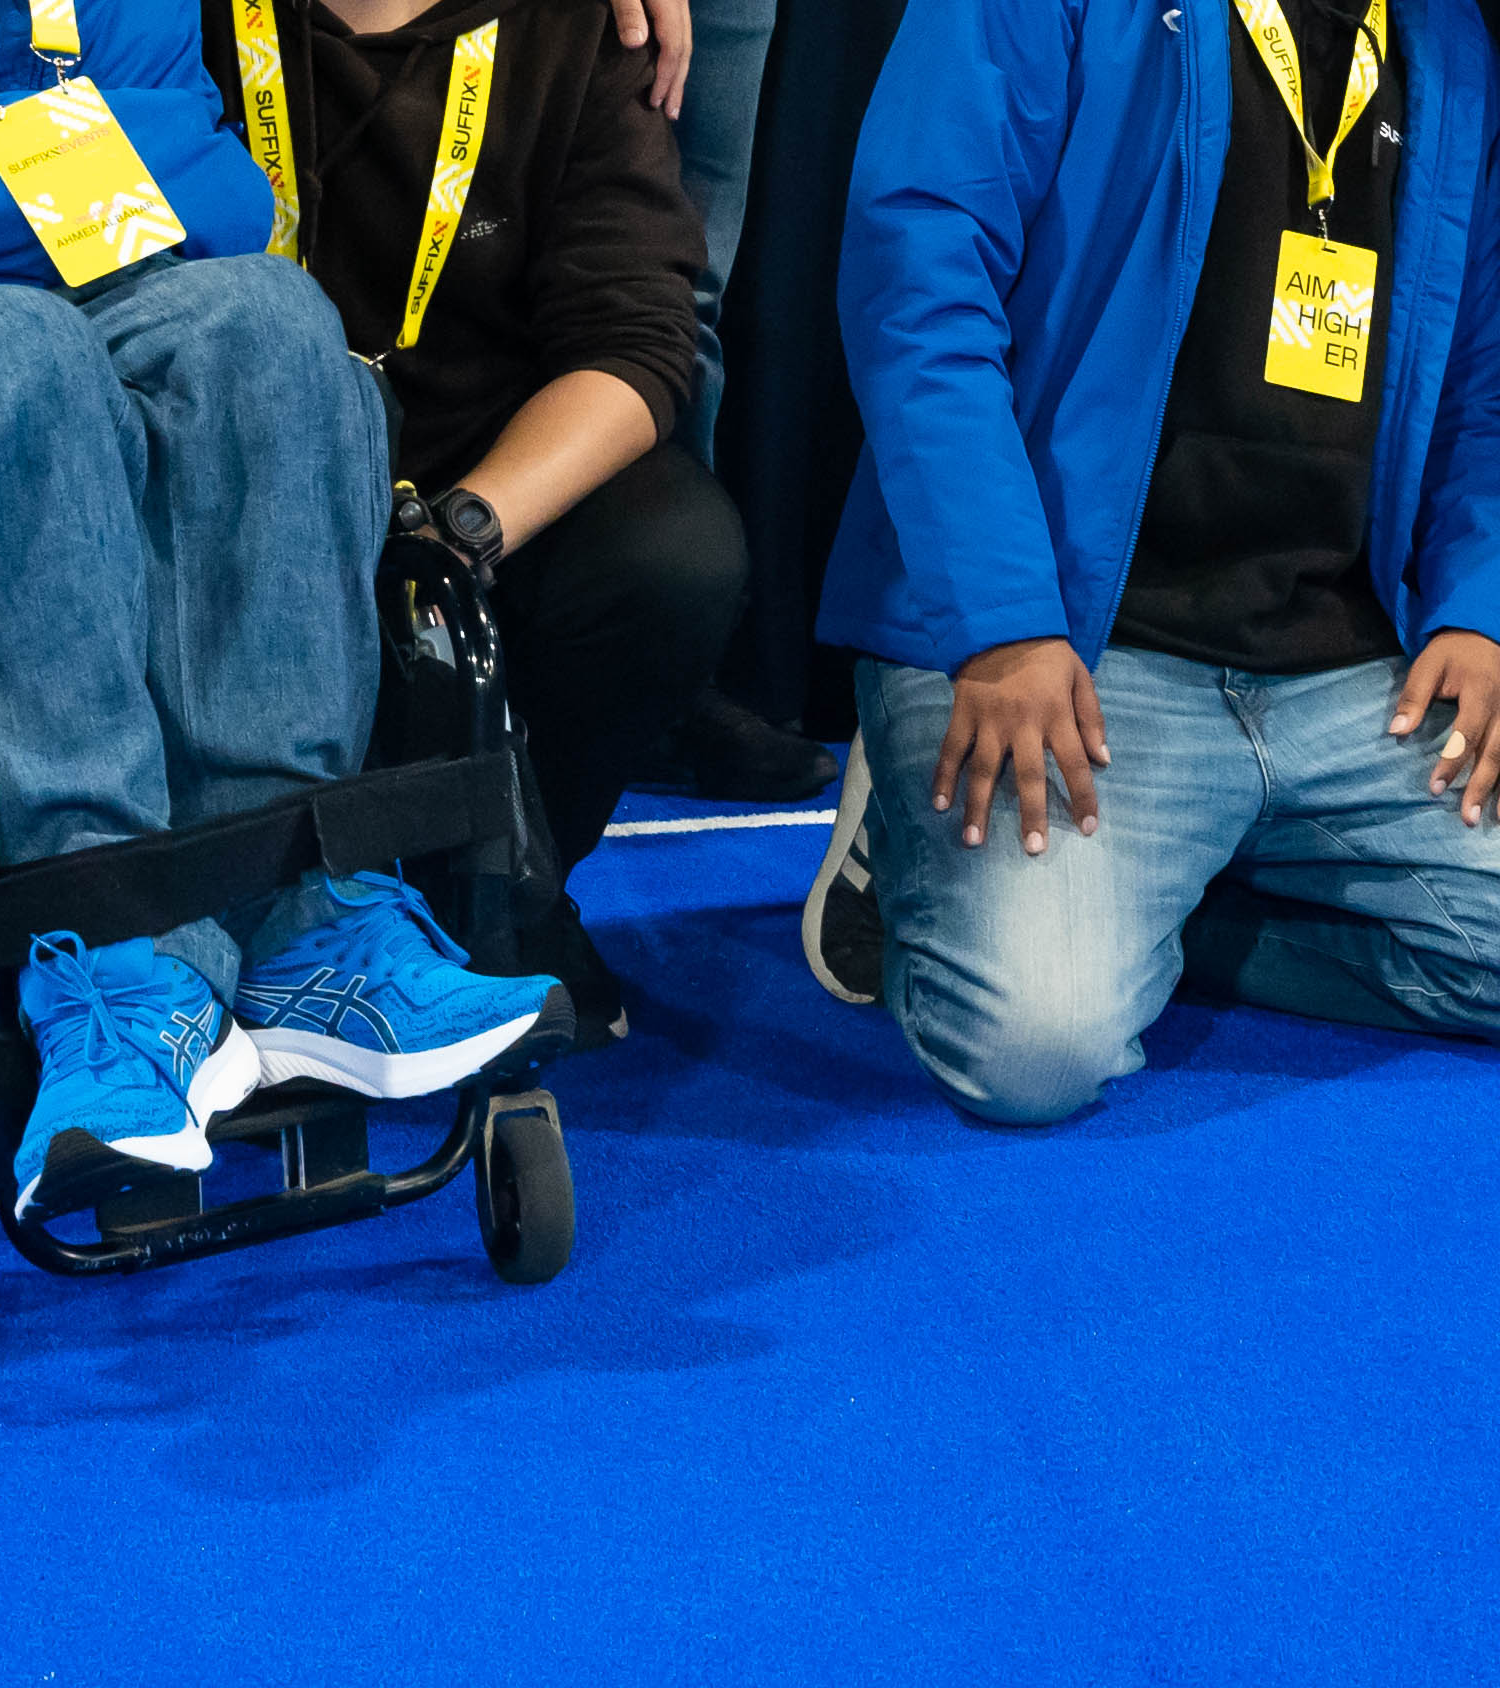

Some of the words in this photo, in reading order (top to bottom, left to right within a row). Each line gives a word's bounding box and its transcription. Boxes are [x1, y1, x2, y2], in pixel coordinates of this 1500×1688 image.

[1263, 26, 1299, 98] SUFFIX
[254, 89, 283, 174] SUFFIX
[451, 79, 478, 162] SUFFIX
[56, 224, 100, 249] AHMED
[410, 233, 445, 316] SUFFIX
[1285, 271, 1336, 302] AIM
[1298, 304, 1362, 340] HIGH
[1324, 342, 1359, 371] ER
